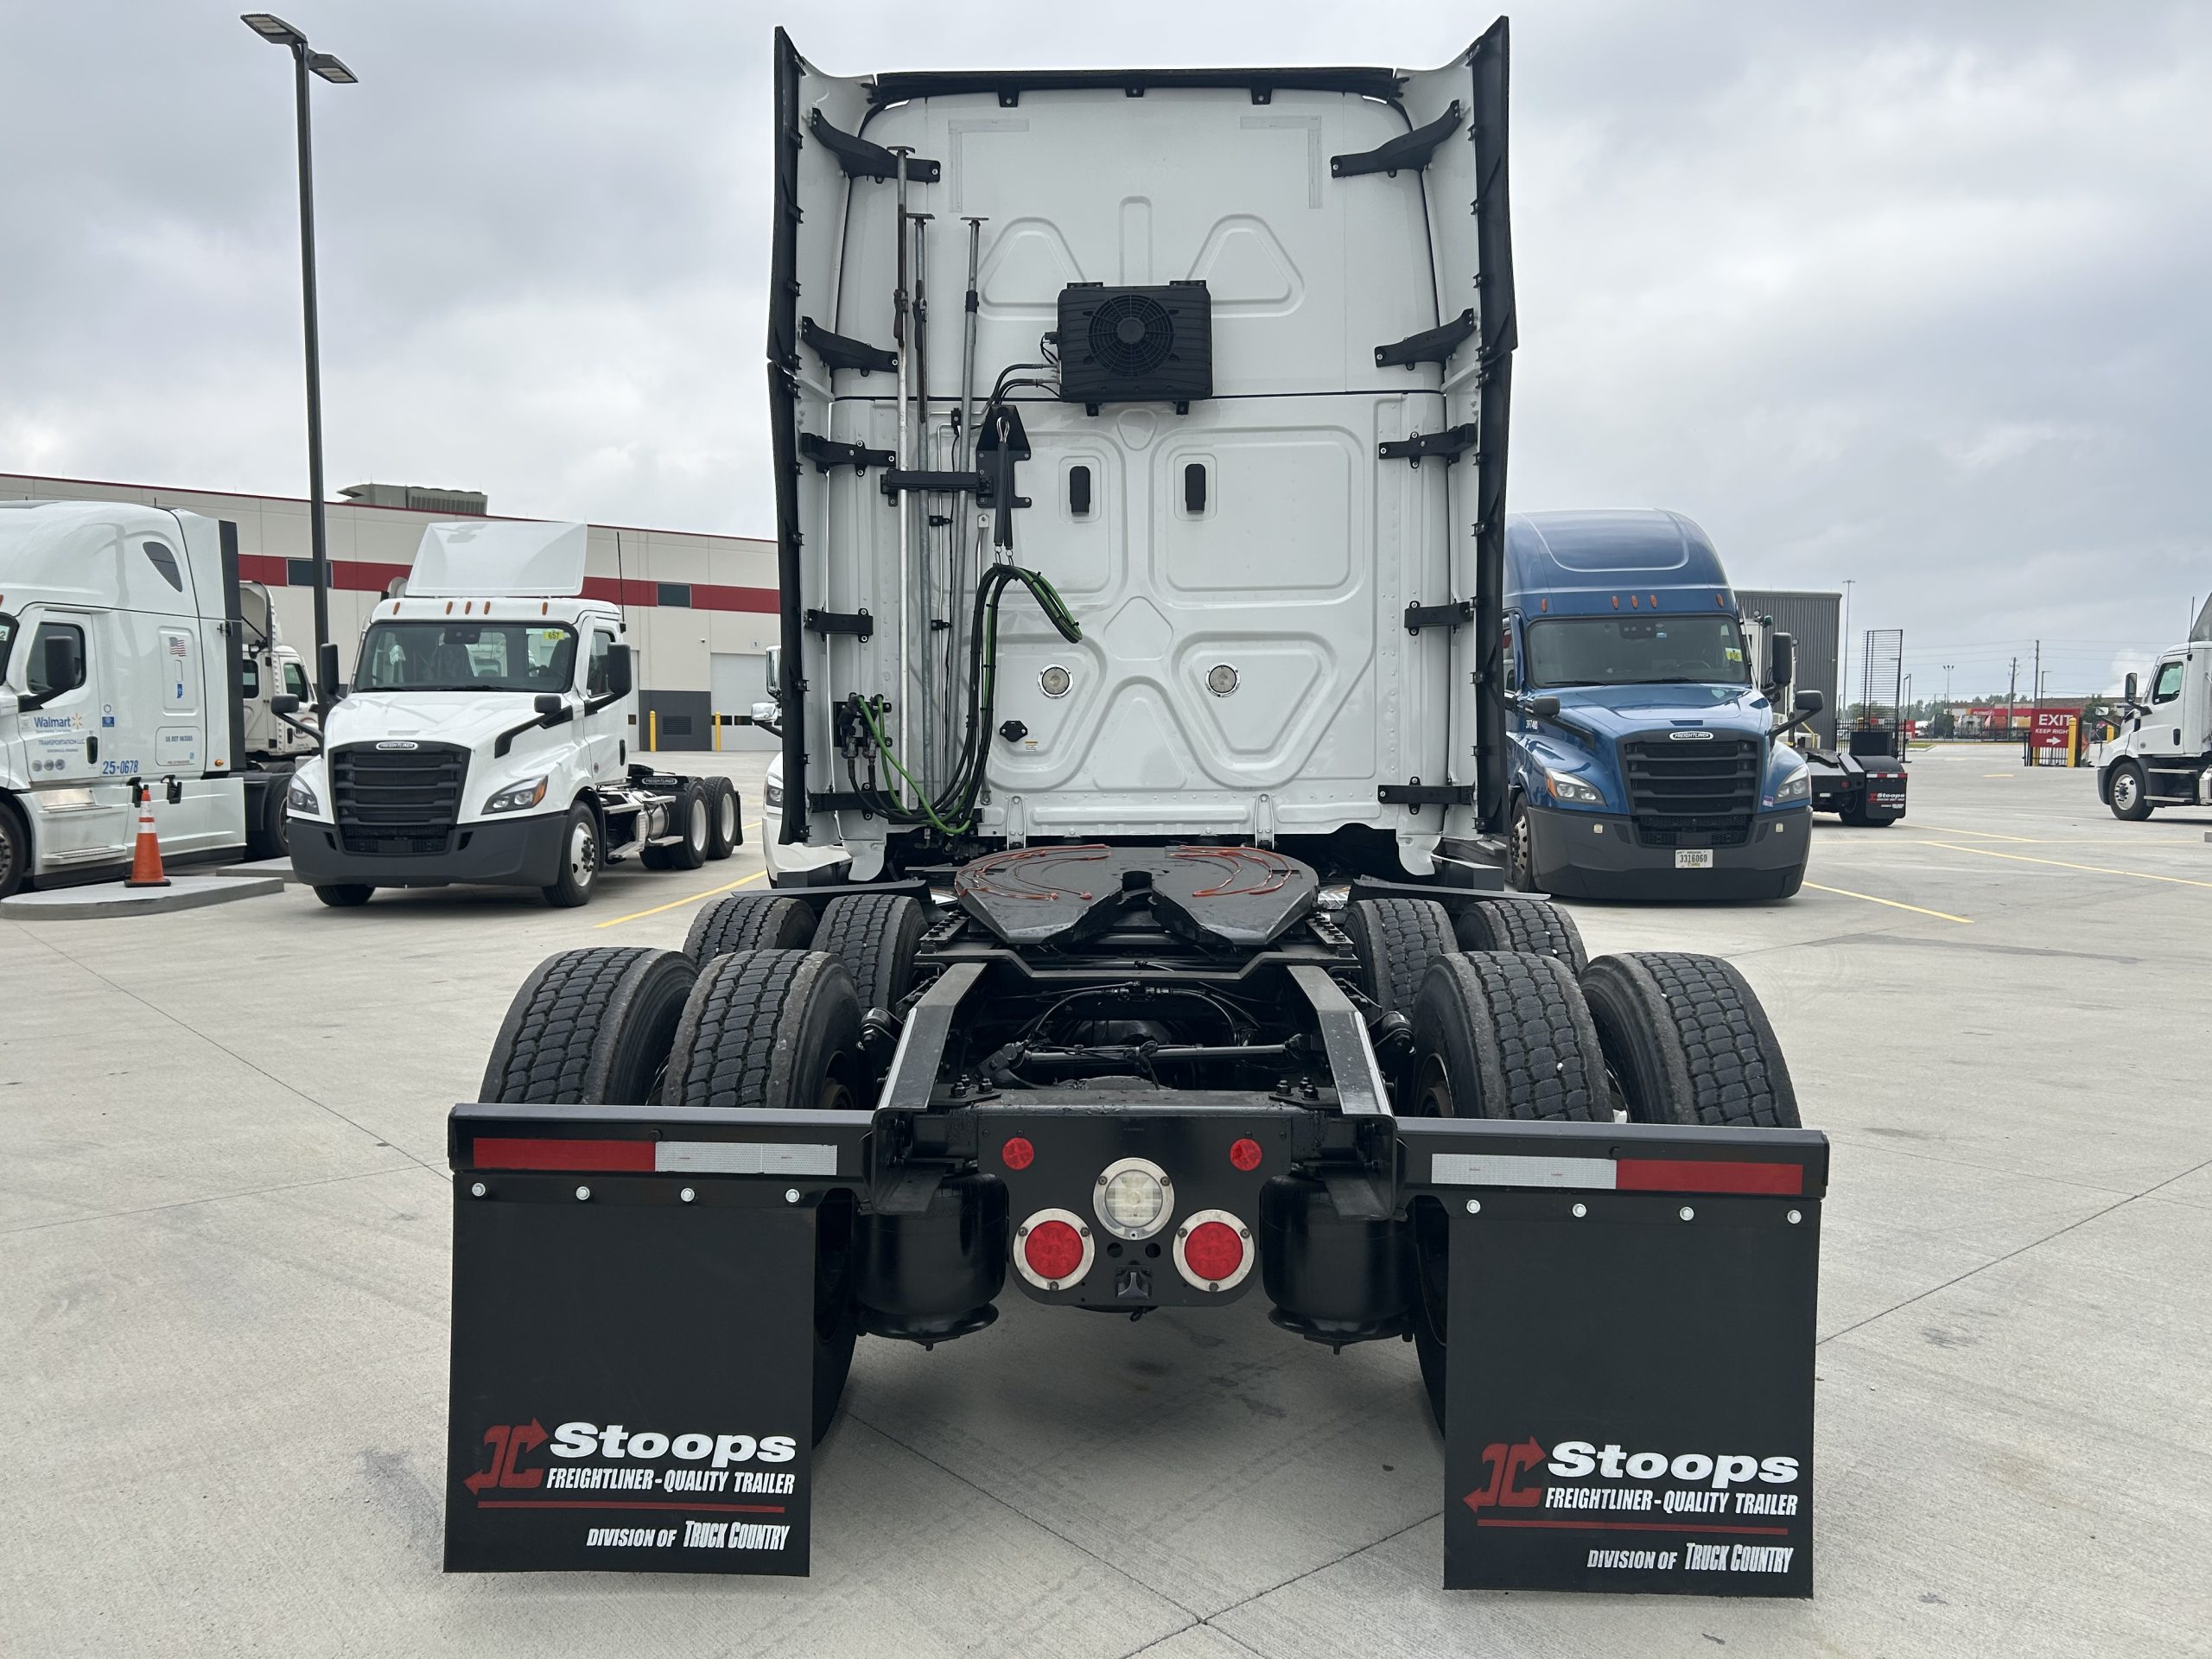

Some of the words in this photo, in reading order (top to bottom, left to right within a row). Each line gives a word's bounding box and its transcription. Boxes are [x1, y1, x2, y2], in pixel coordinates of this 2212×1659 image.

[34, 715, 71, 728] Walmart
[2039, 714, 2074, 727] EXIT
[550, 1422, 797, 1467] Stoops
[1548, 1441, 1800, 1489] Stoops
[734, 1472, 796, 1495] TRAILER
[1735, 1492, 1798, 1516] TRAILER
[587, 1528, 654, 1548] DIVISION
[657, 1529, 677, 1548] OF
[683, 1520, 727, 1548] TRUCK
[728, 1522, 791, 1551] COUNTRY
[1586, 1549, 1655, 1569] DIVISION
[1657, 1551, 1678, 1570] OF
[1684, 1542, 1729, 1571] TRUCK
[1730, 1544, 1795, 1573] COUNTRY
